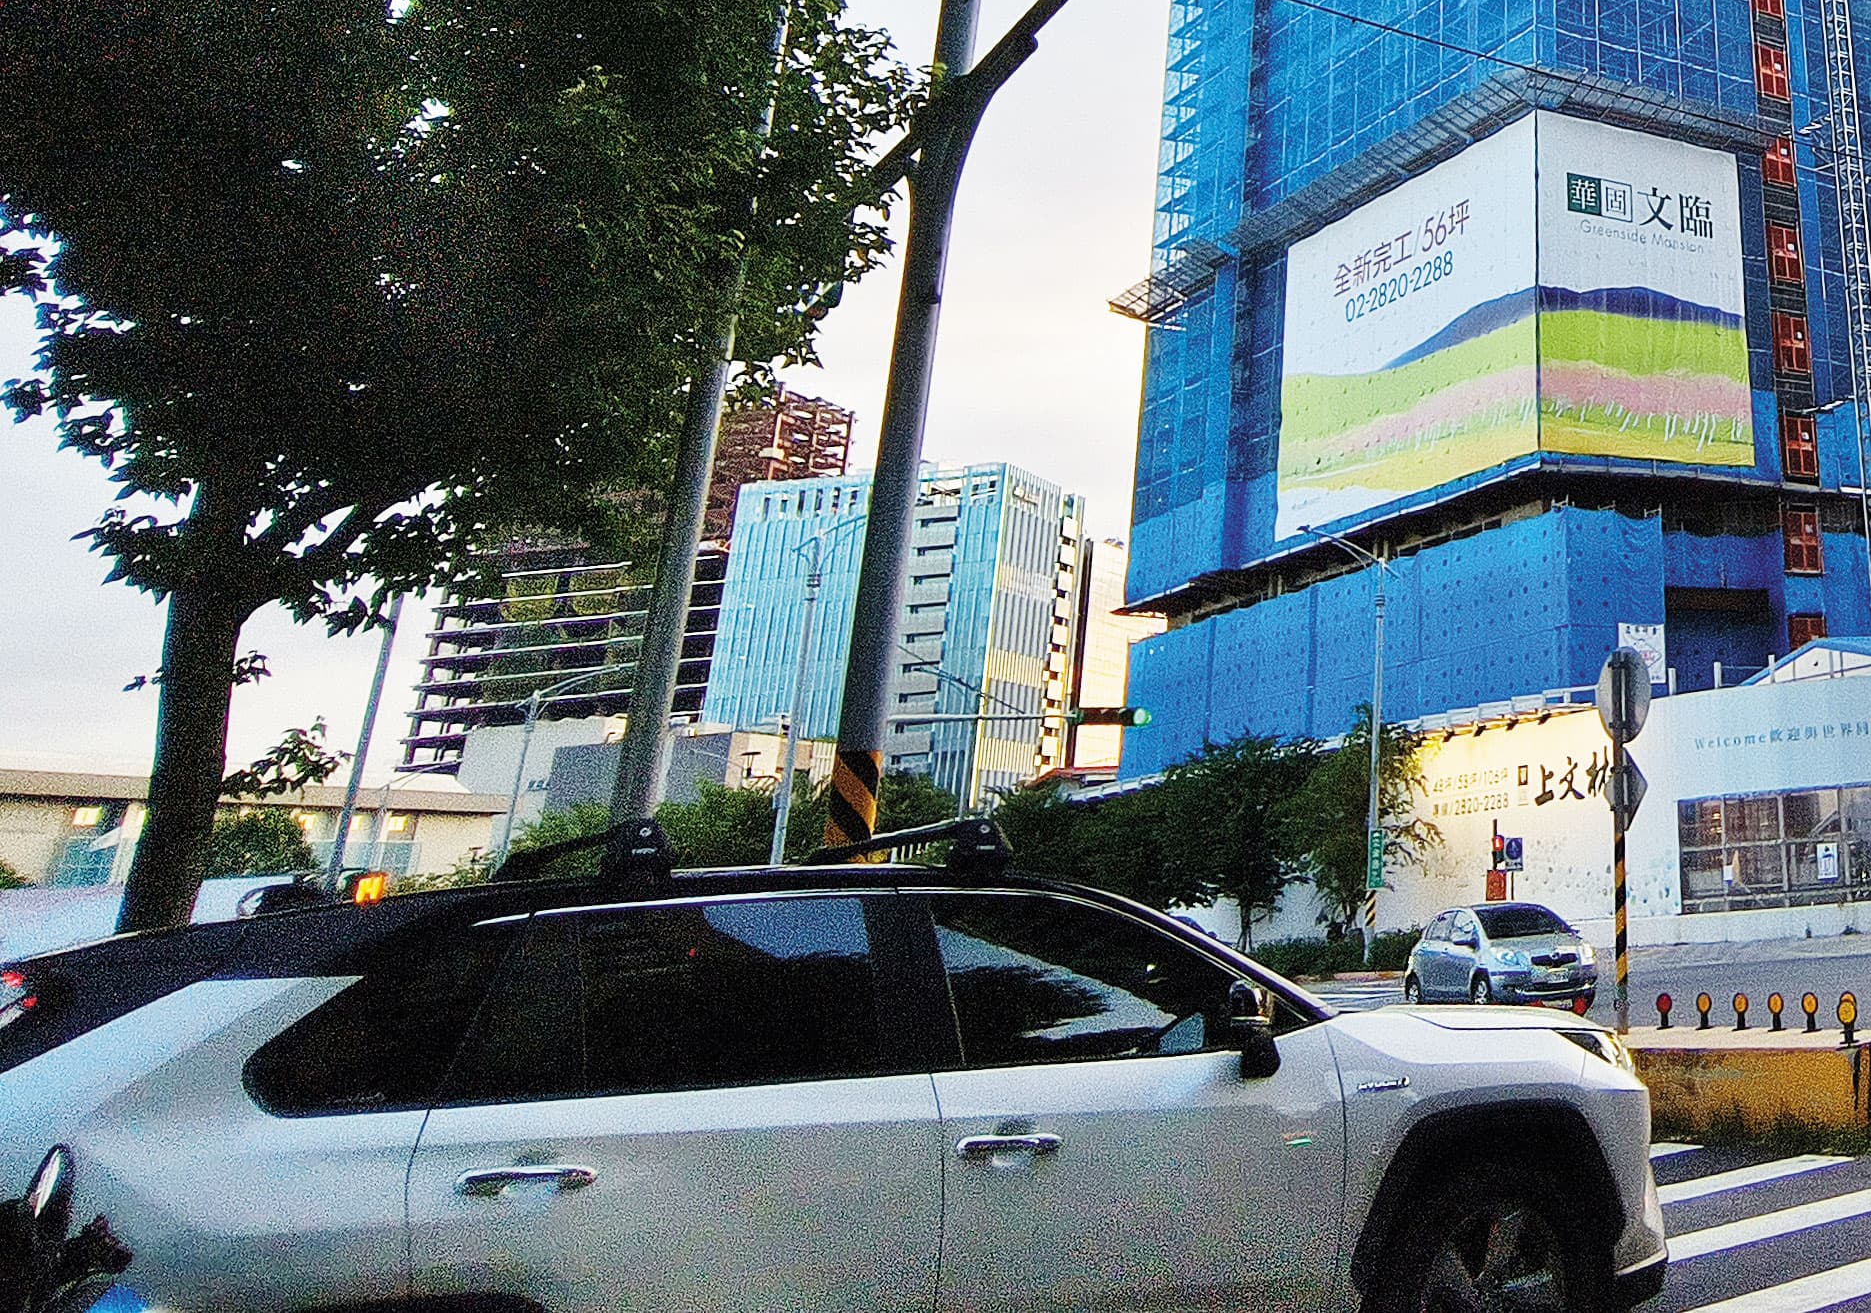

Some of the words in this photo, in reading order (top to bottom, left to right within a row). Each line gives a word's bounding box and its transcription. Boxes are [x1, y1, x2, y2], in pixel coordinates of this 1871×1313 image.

[1580, 219, 1647, 244] Greenside
[1651, 233, 1704, 254] Mansion
[1345, 250, 1453, 322] 02-2820-2288
